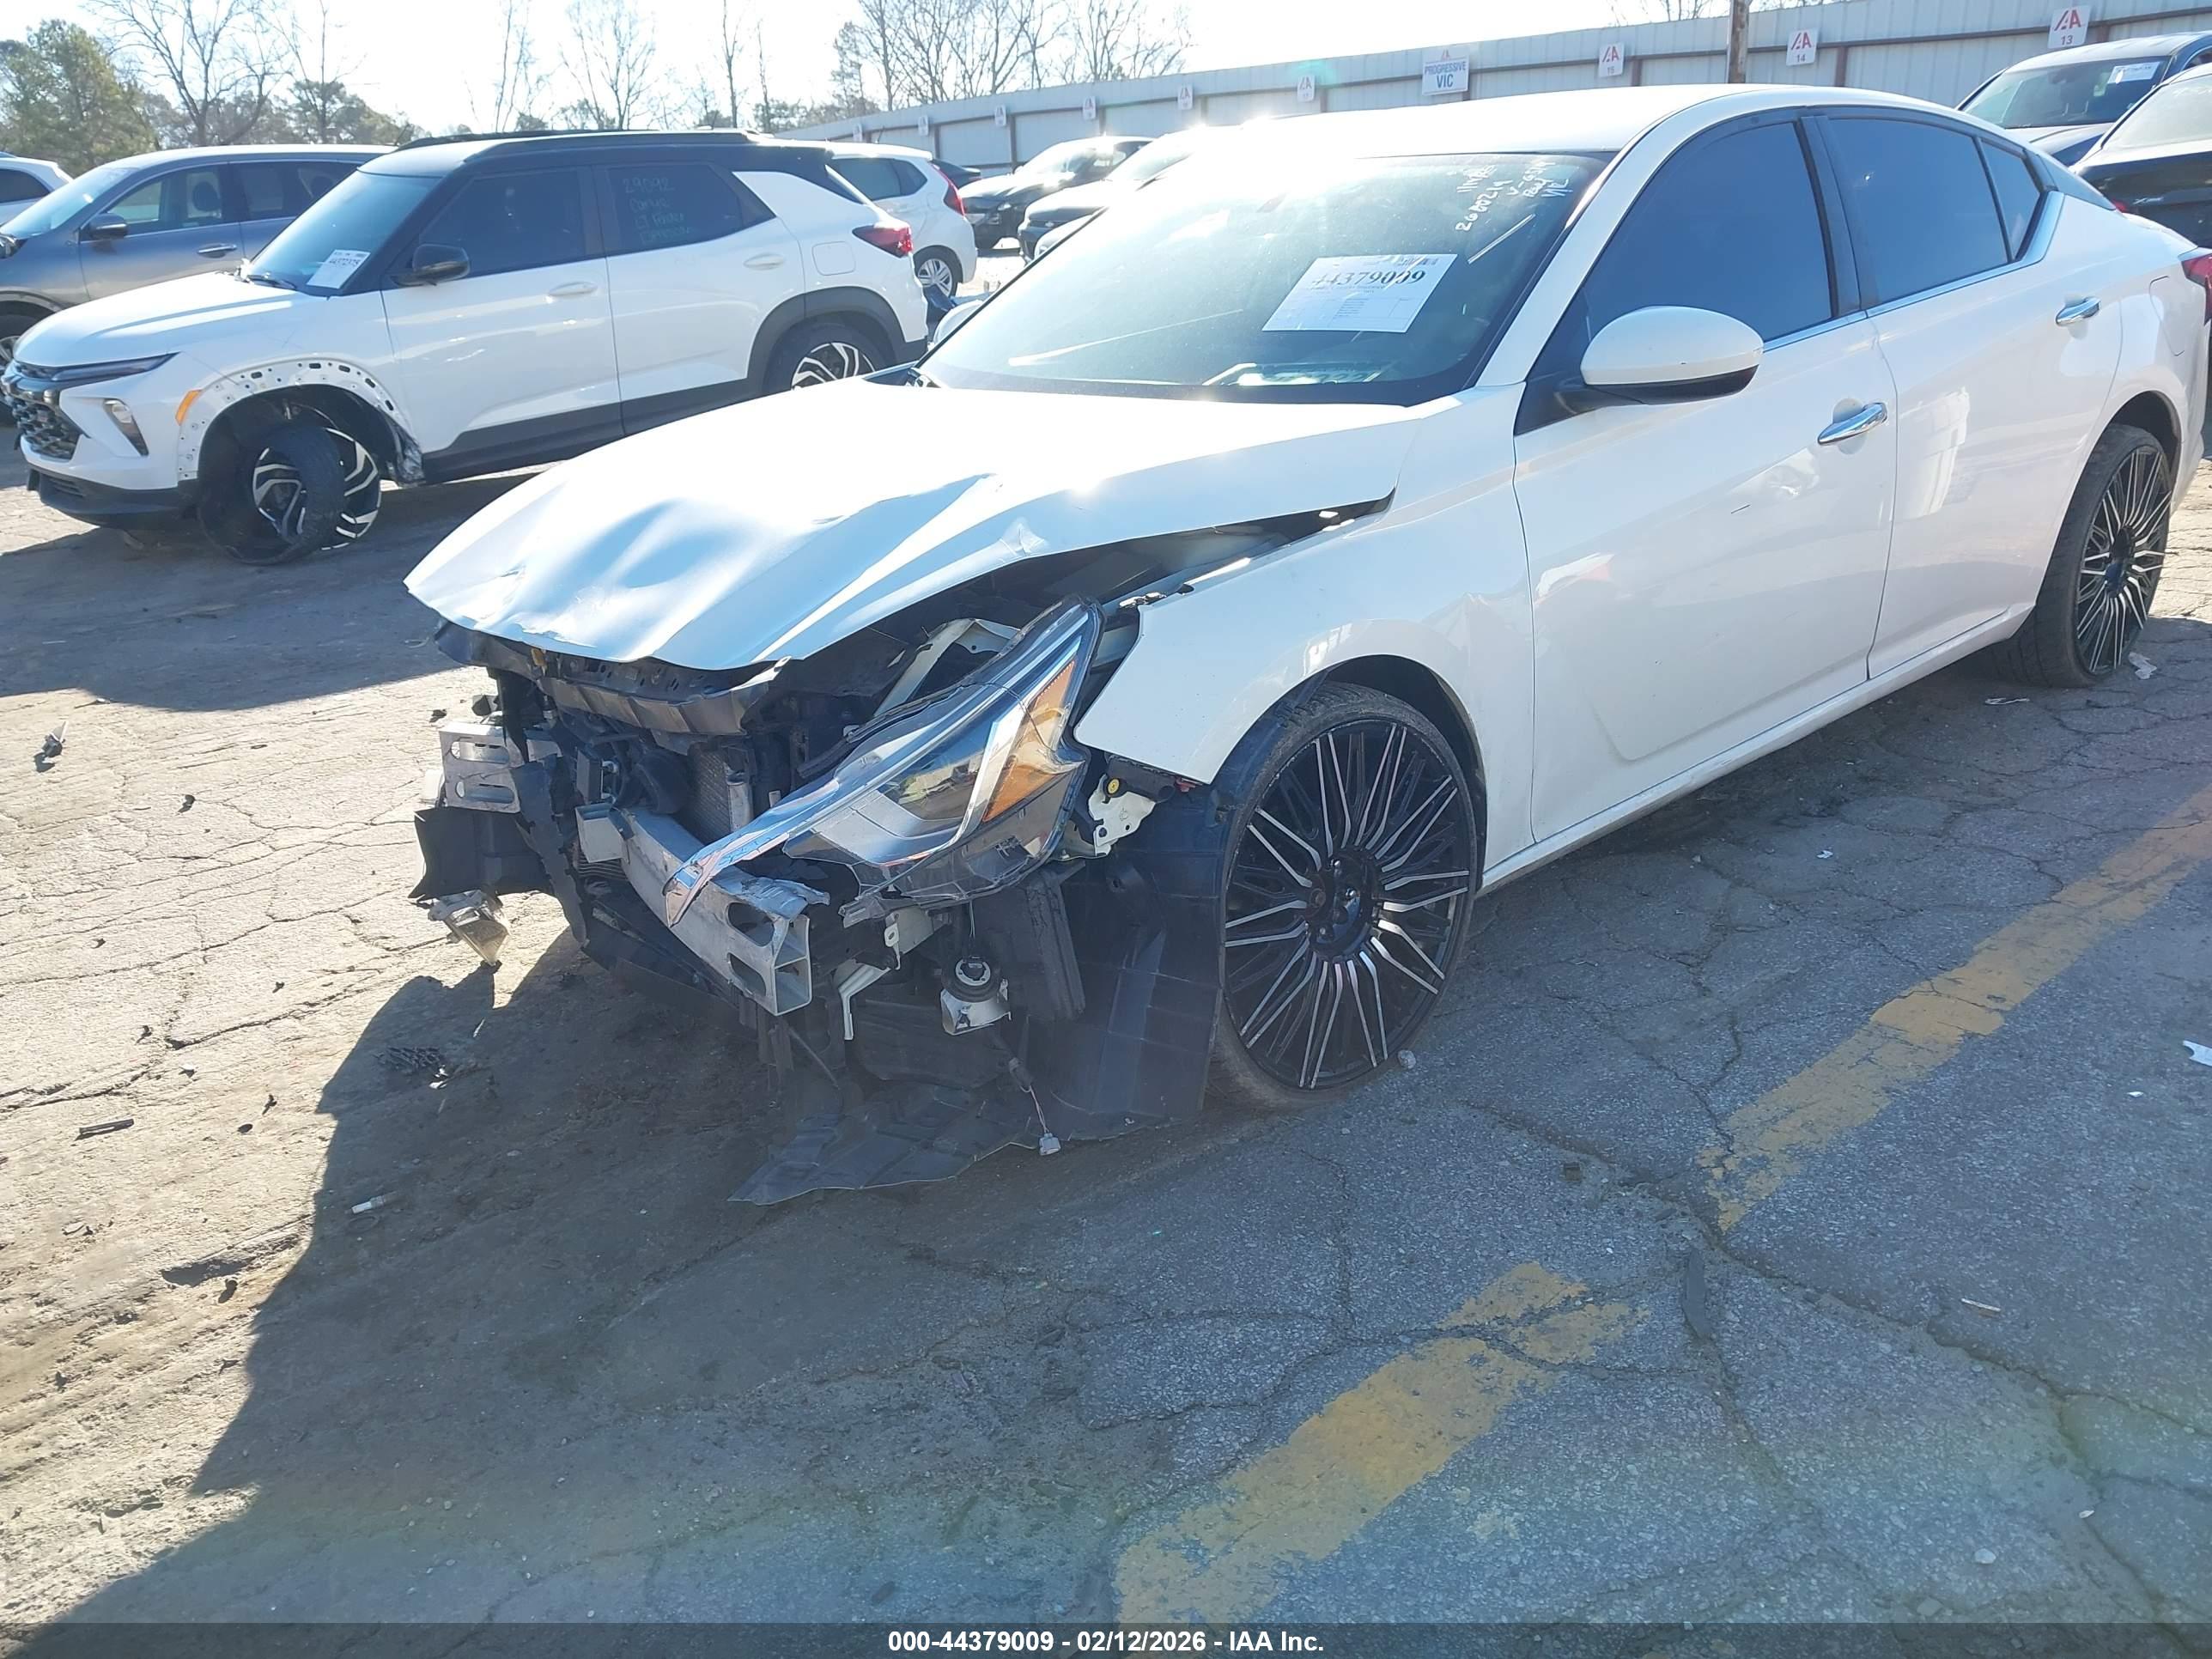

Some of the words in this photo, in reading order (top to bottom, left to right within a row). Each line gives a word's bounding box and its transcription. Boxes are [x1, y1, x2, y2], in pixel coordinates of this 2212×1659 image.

[2061, 34, 2074, 46] 13
[1425, 61, 1467, 75] PROGRESSIVE
[1436, 73, 1454, 88] VIC
